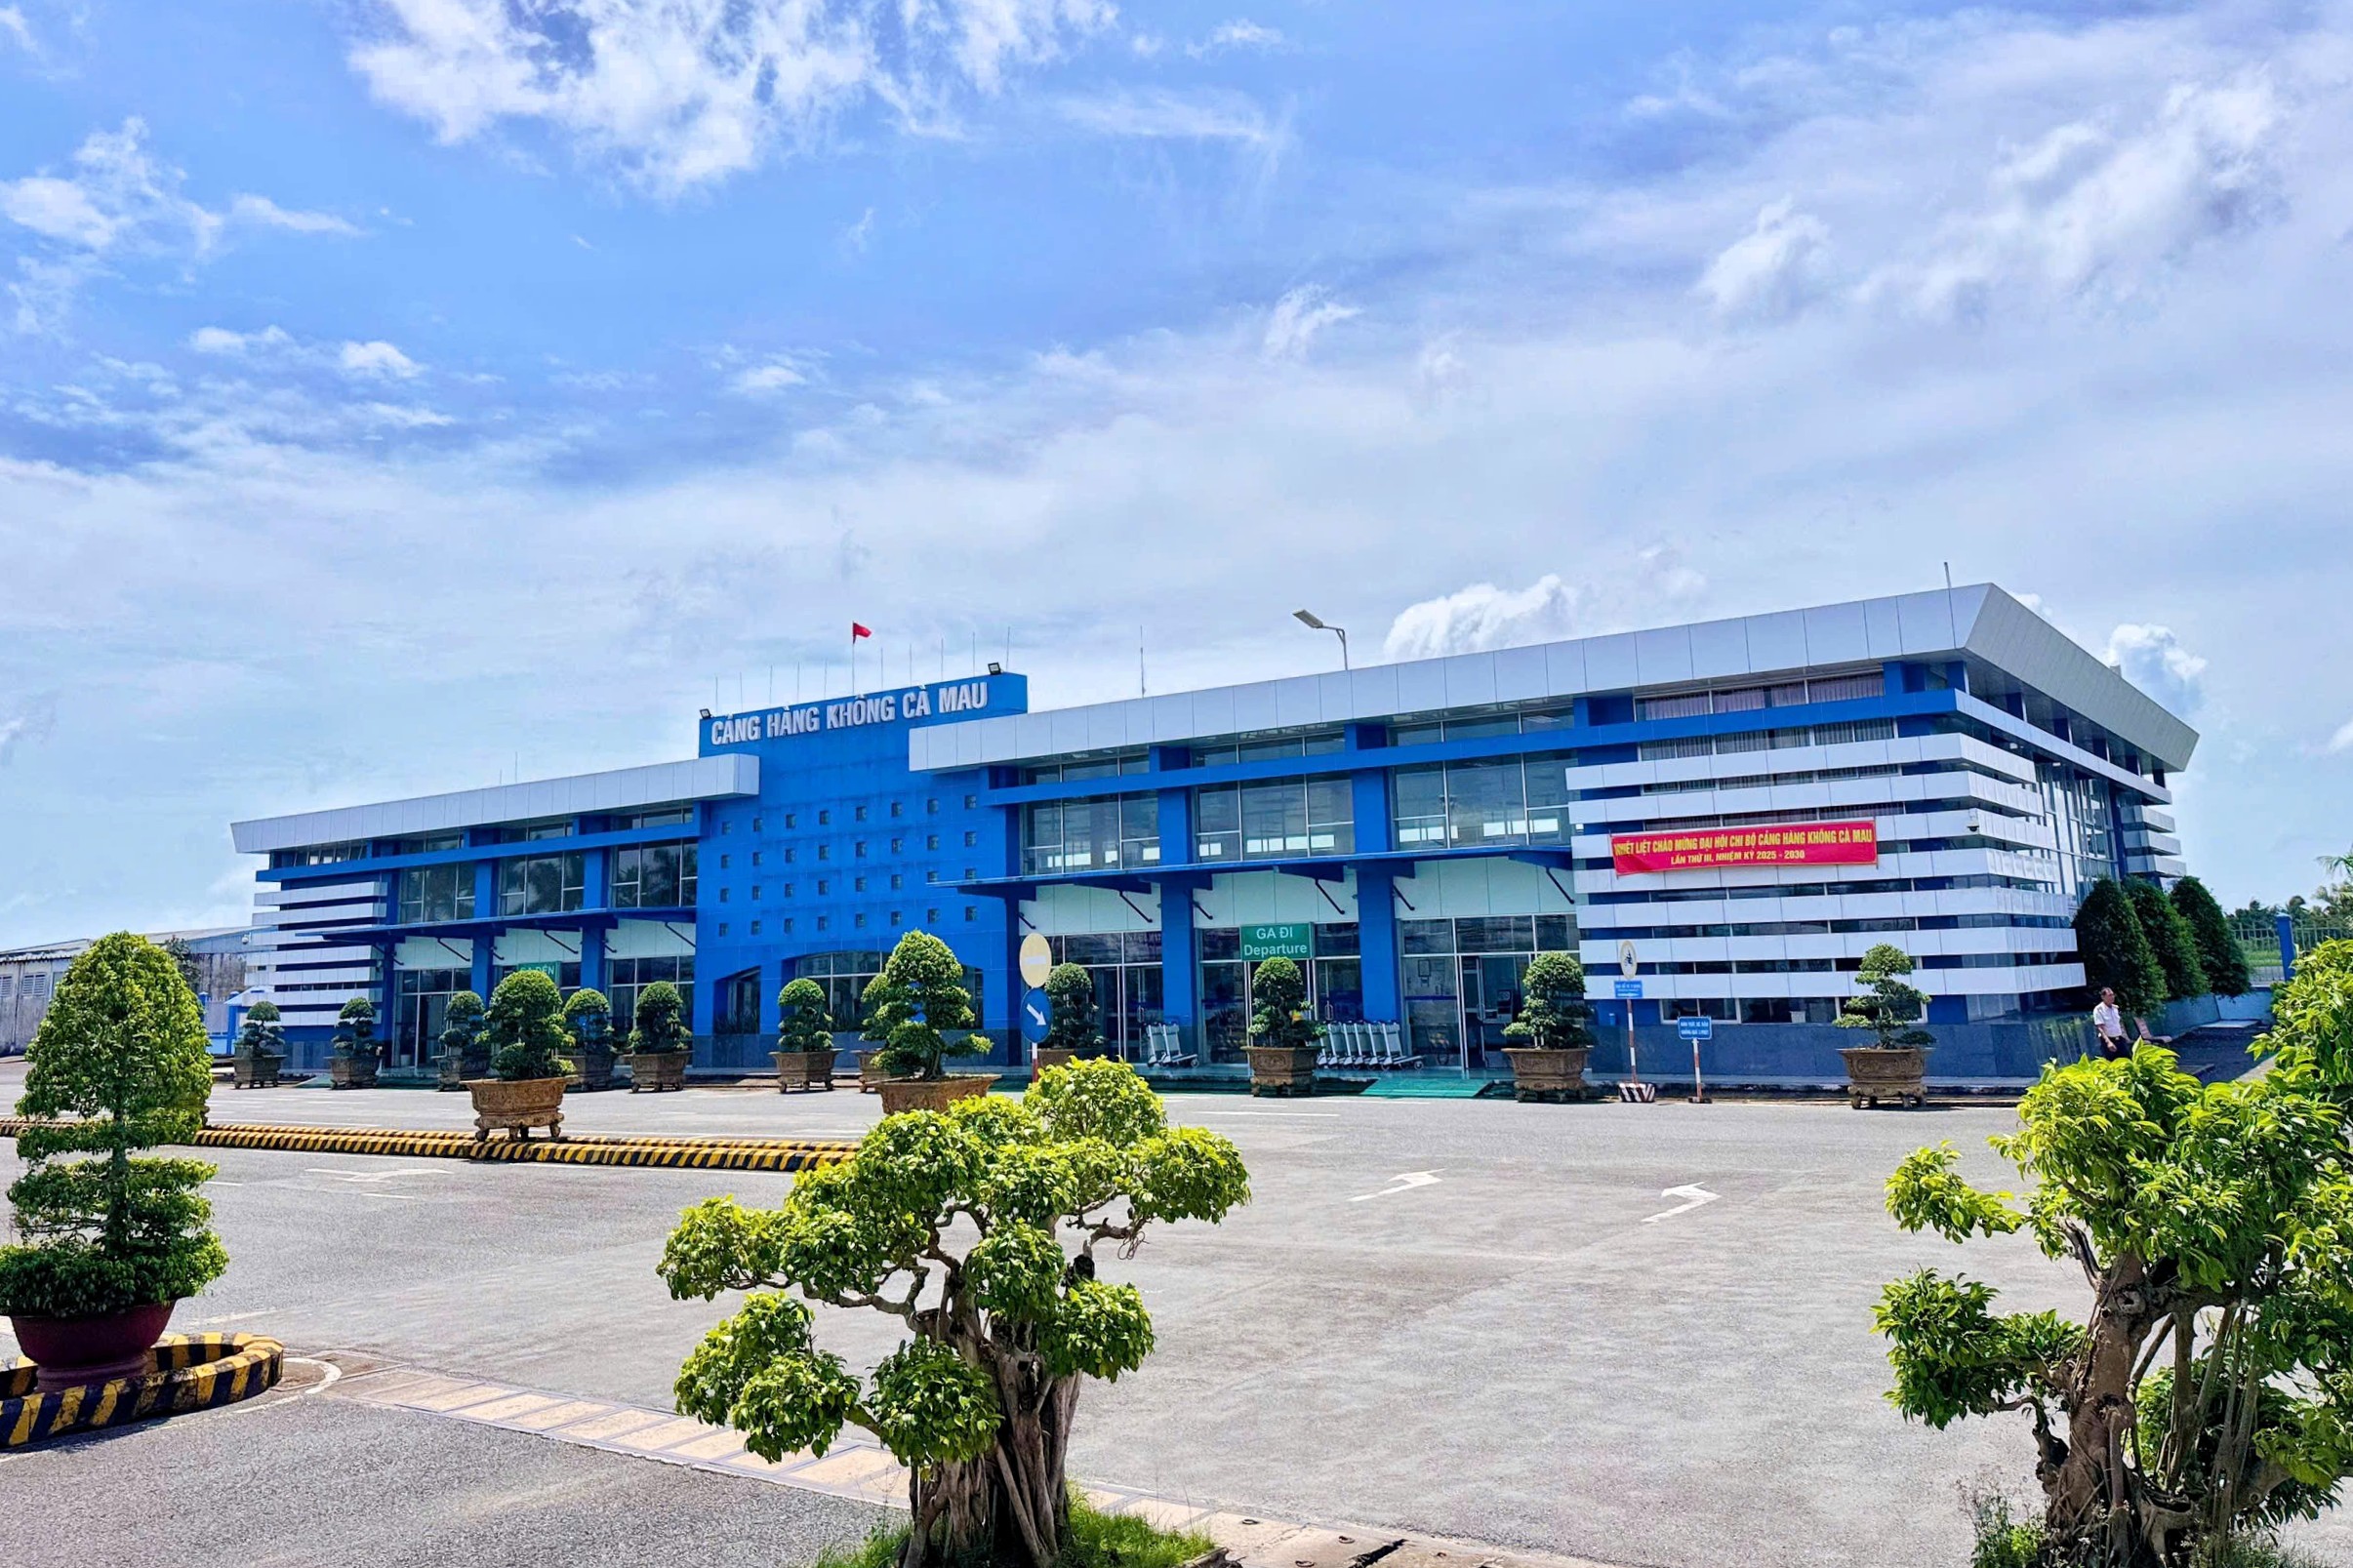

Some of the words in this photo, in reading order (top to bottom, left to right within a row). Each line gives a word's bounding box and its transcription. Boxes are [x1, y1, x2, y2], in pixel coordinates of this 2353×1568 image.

[767, 706, 820, 739] HÀNG
[827, 694, 895, 729] KHÔNG
[903, 685, 931, 718] CÀ
[939, 682, 988, 713] MAU
[1653, 838, 1674, 853] CHÀO
[1729, 835, 1744, 847] CHI
[1745, 832, 1757, 849] BỘ
[1758, 829, 1781, 846] CẢNG
[1782, 829, 1805, 845] HÀNG
[1807, 828, 1837, 844] KHÔNG
[1838, 827, 1851, 843] CÀ
[1852, 829, 1873, 843] MAU
[1757, 851, 1777, 860] 2025
[1784, 850, 1805, 859] 2030
[1256, 928, 1277, 940] GA
[1279, 926, 1293, 938] ĐI
[1244, 944, 1308, 958] Departure
